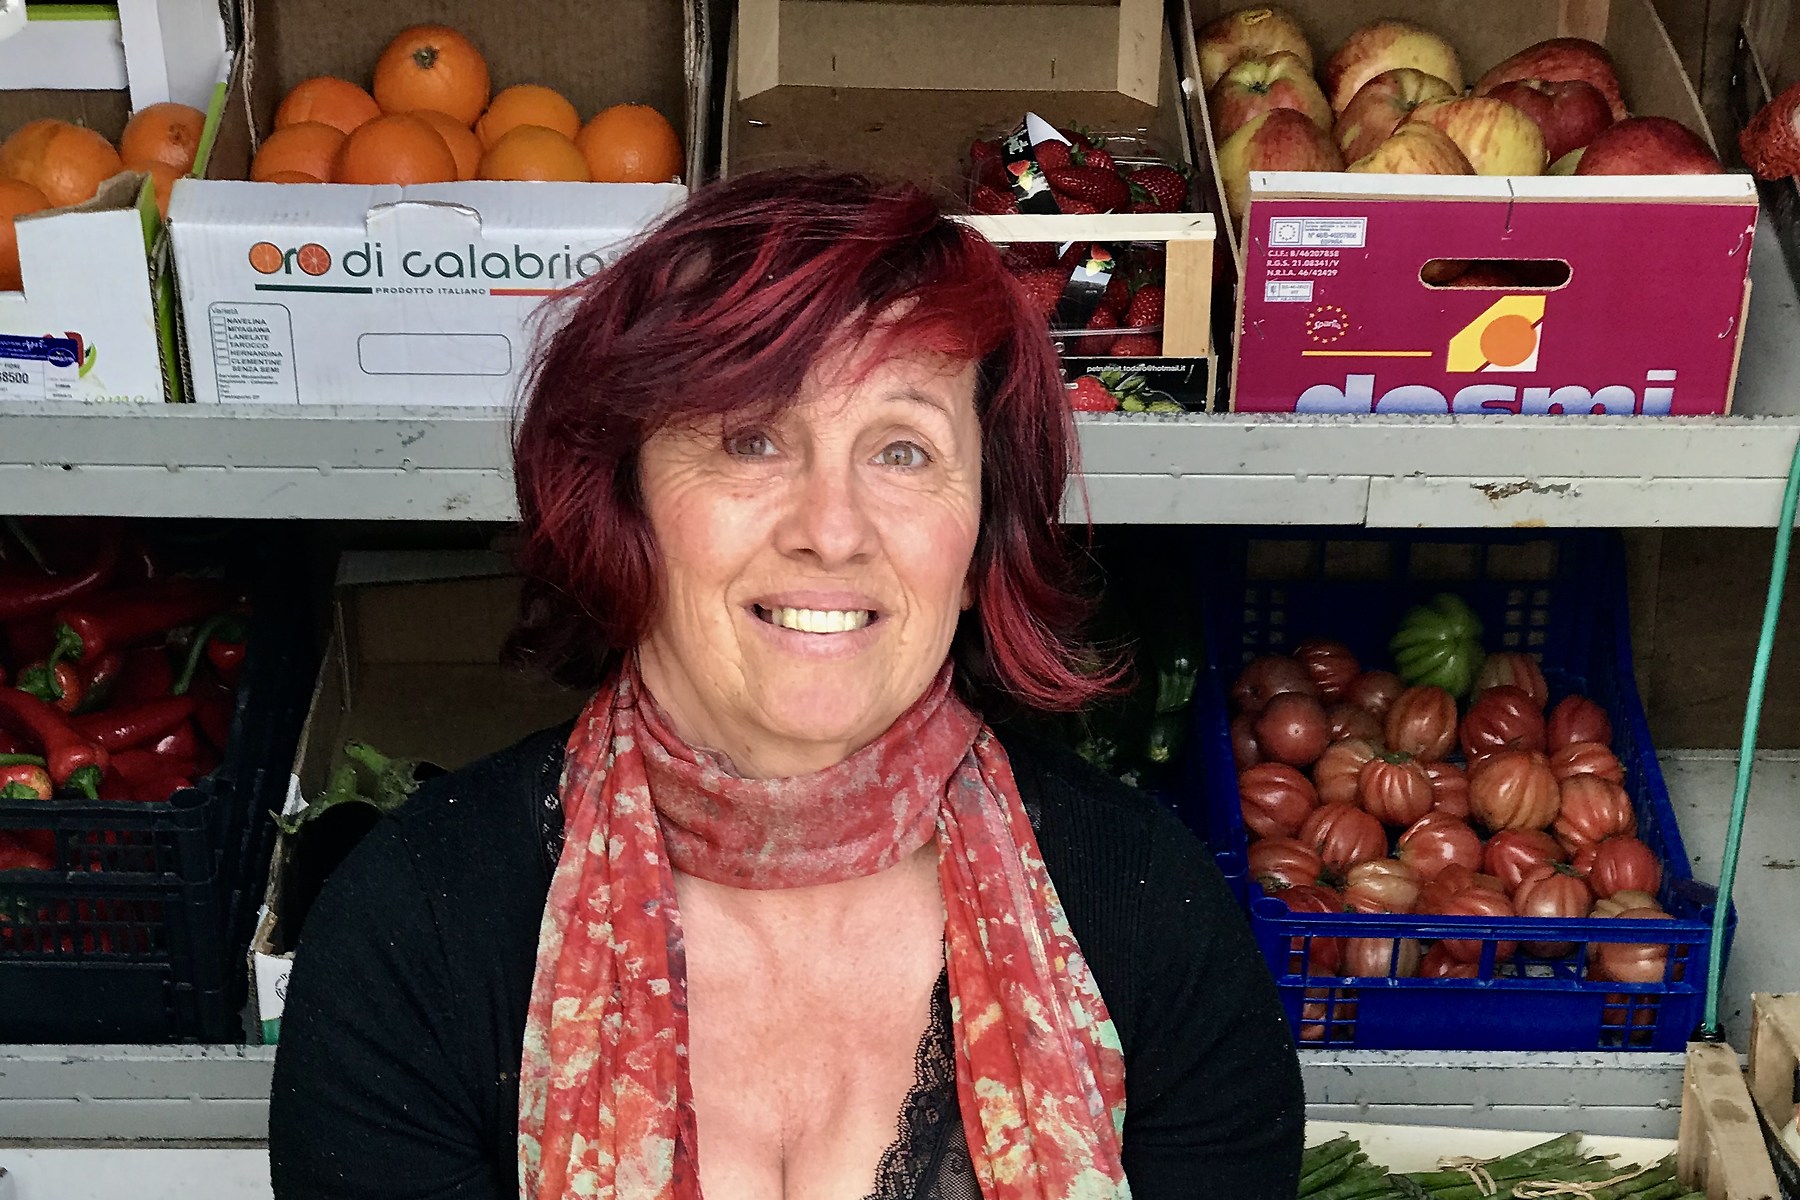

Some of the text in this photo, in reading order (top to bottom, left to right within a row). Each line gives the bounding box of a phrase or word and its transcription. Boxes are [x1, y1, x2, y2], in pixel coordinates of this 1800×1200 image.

[343, 242, 384, 278] di
[375, 286, 486, 295] PRODOTTO ITALIANO
[230, 349, 283, 357] HERNANDINA
[231, 358, 282, 366] CLEMENTINE
